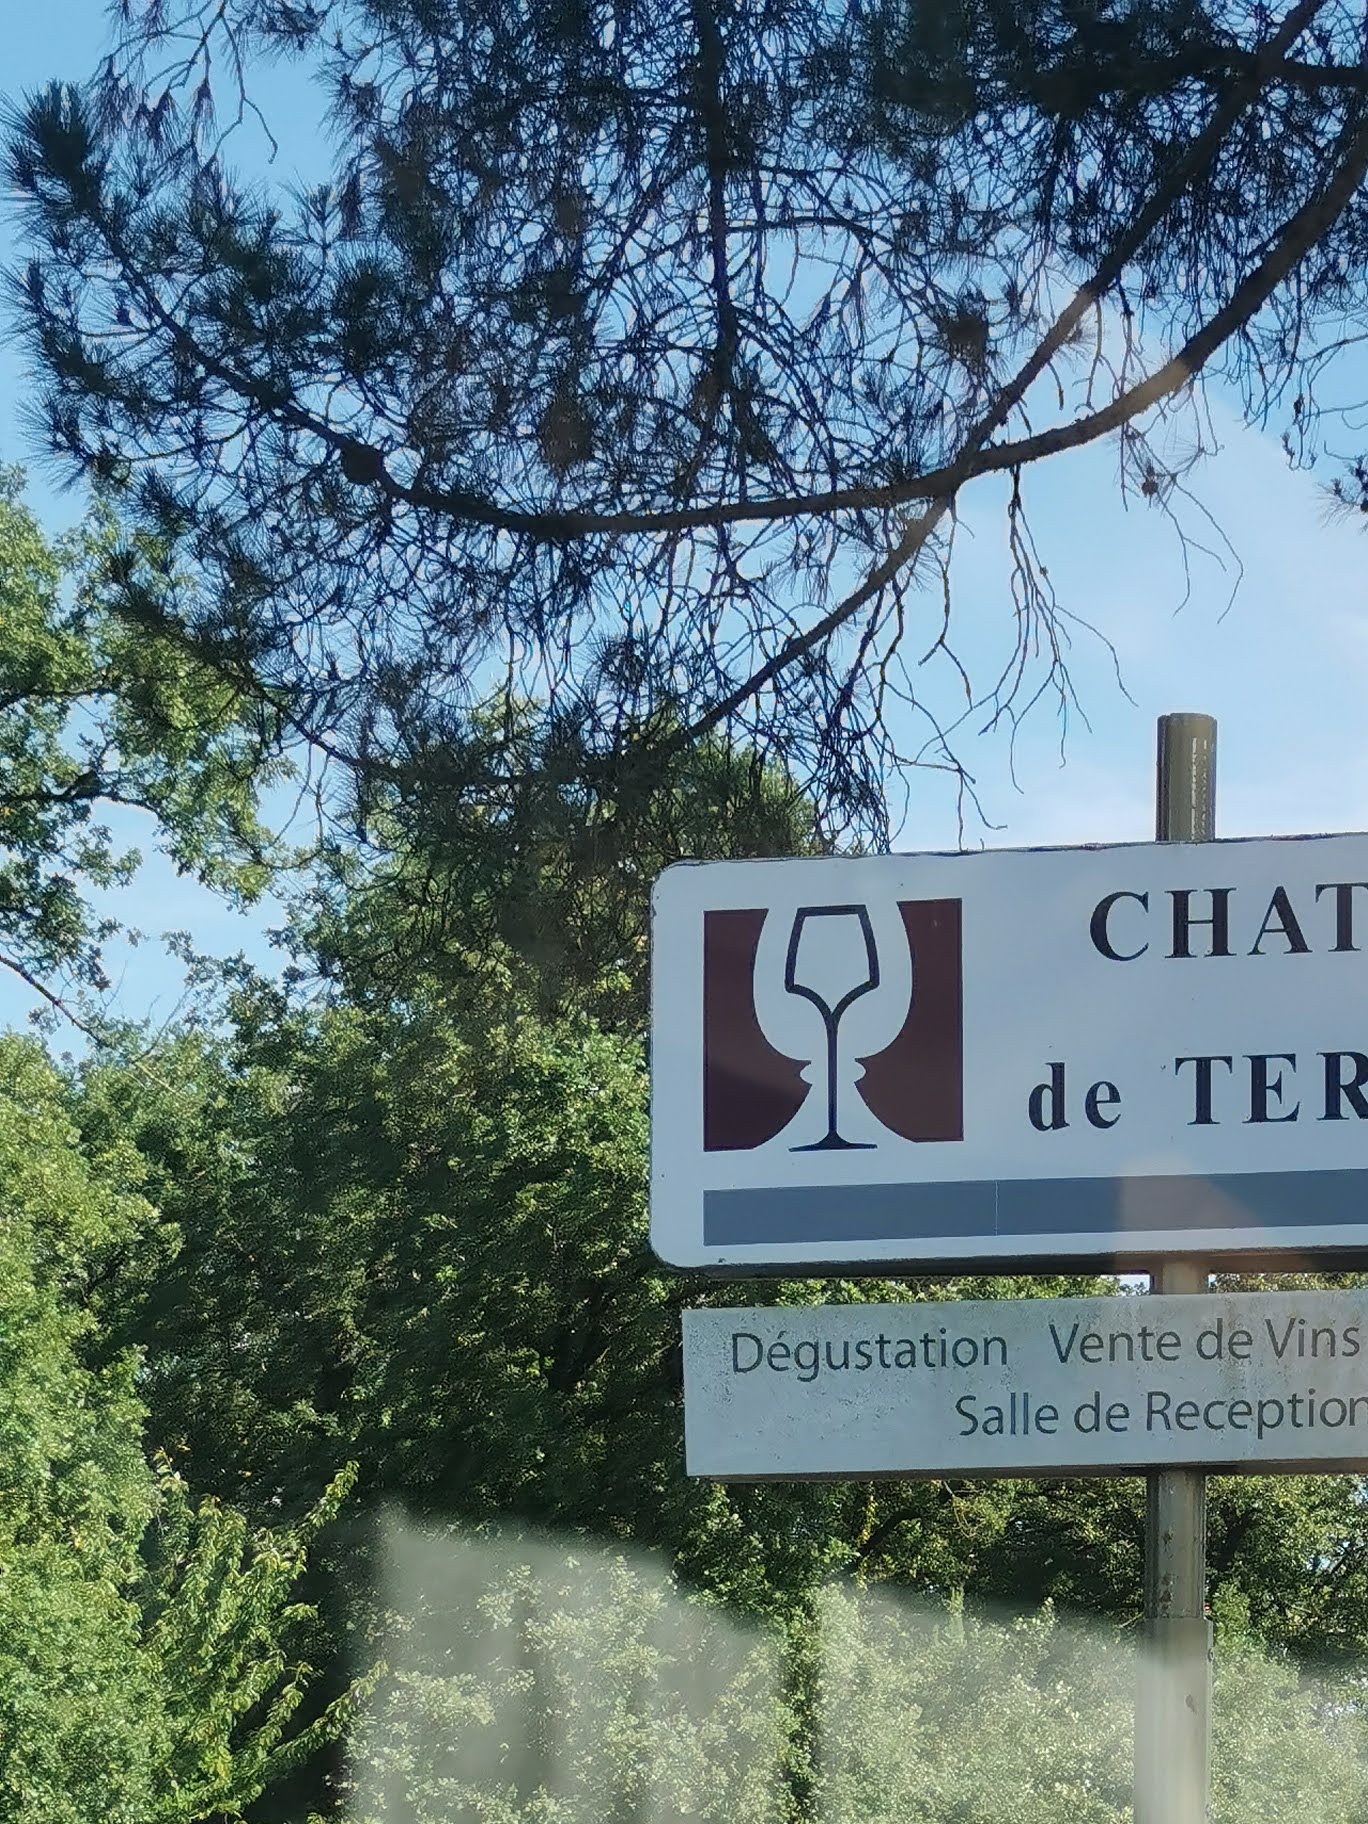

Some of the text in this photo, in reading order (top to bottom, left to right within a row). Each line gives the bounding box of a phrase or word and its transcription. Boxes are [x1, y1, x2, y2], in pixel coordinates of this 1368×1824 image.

[1028, 1061, 1122, 1132] de
[731, 1329, 1008, 1383] Dégustation
[1048, 1322, 1182, 1364] Vente
[1195, 1317, 1254, 1362] de
[1264, 1317, 1361, 1360] Vins
[954, 1391, 1059, 1437] Salle
[1073, 1390, 1130, 1434] de
